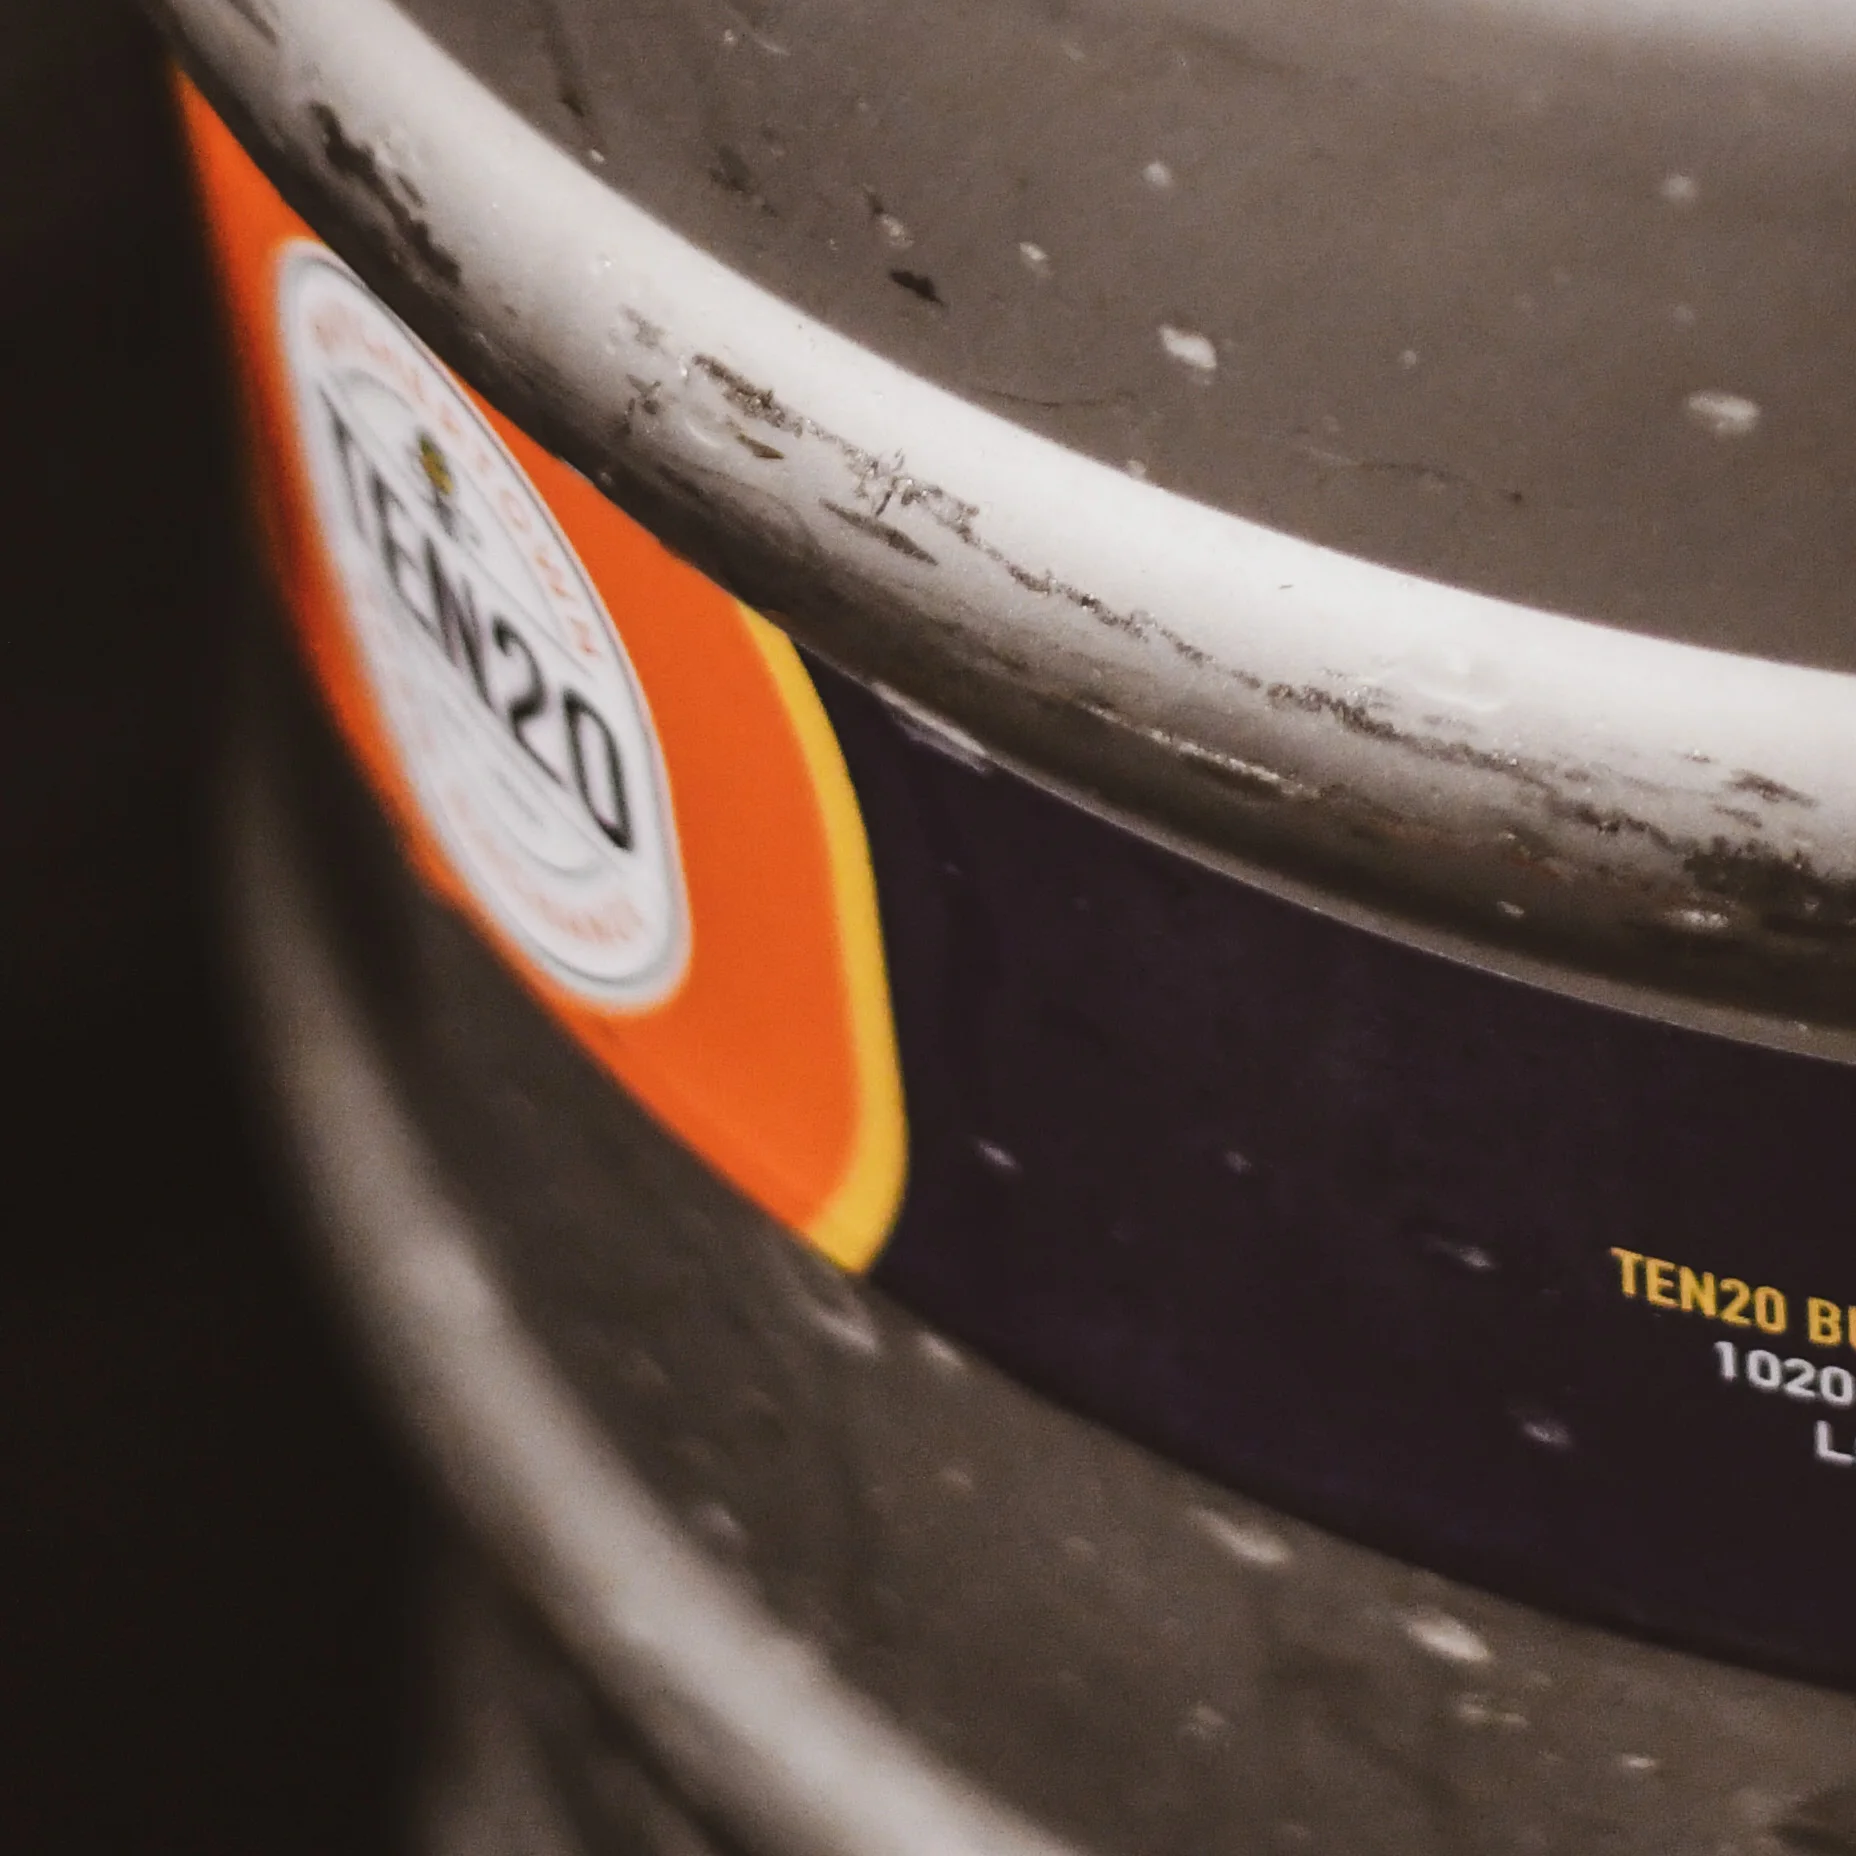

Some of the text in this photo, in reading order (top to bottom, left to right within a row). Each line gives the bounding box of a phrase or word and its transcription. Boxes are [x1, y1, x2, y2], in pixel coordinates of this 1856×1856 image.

[317, 382, 637, 855] TEN20
[1610, 1245, 1788, 1335] TEN20
[1713, 1340, 1856, 1408] 1020
